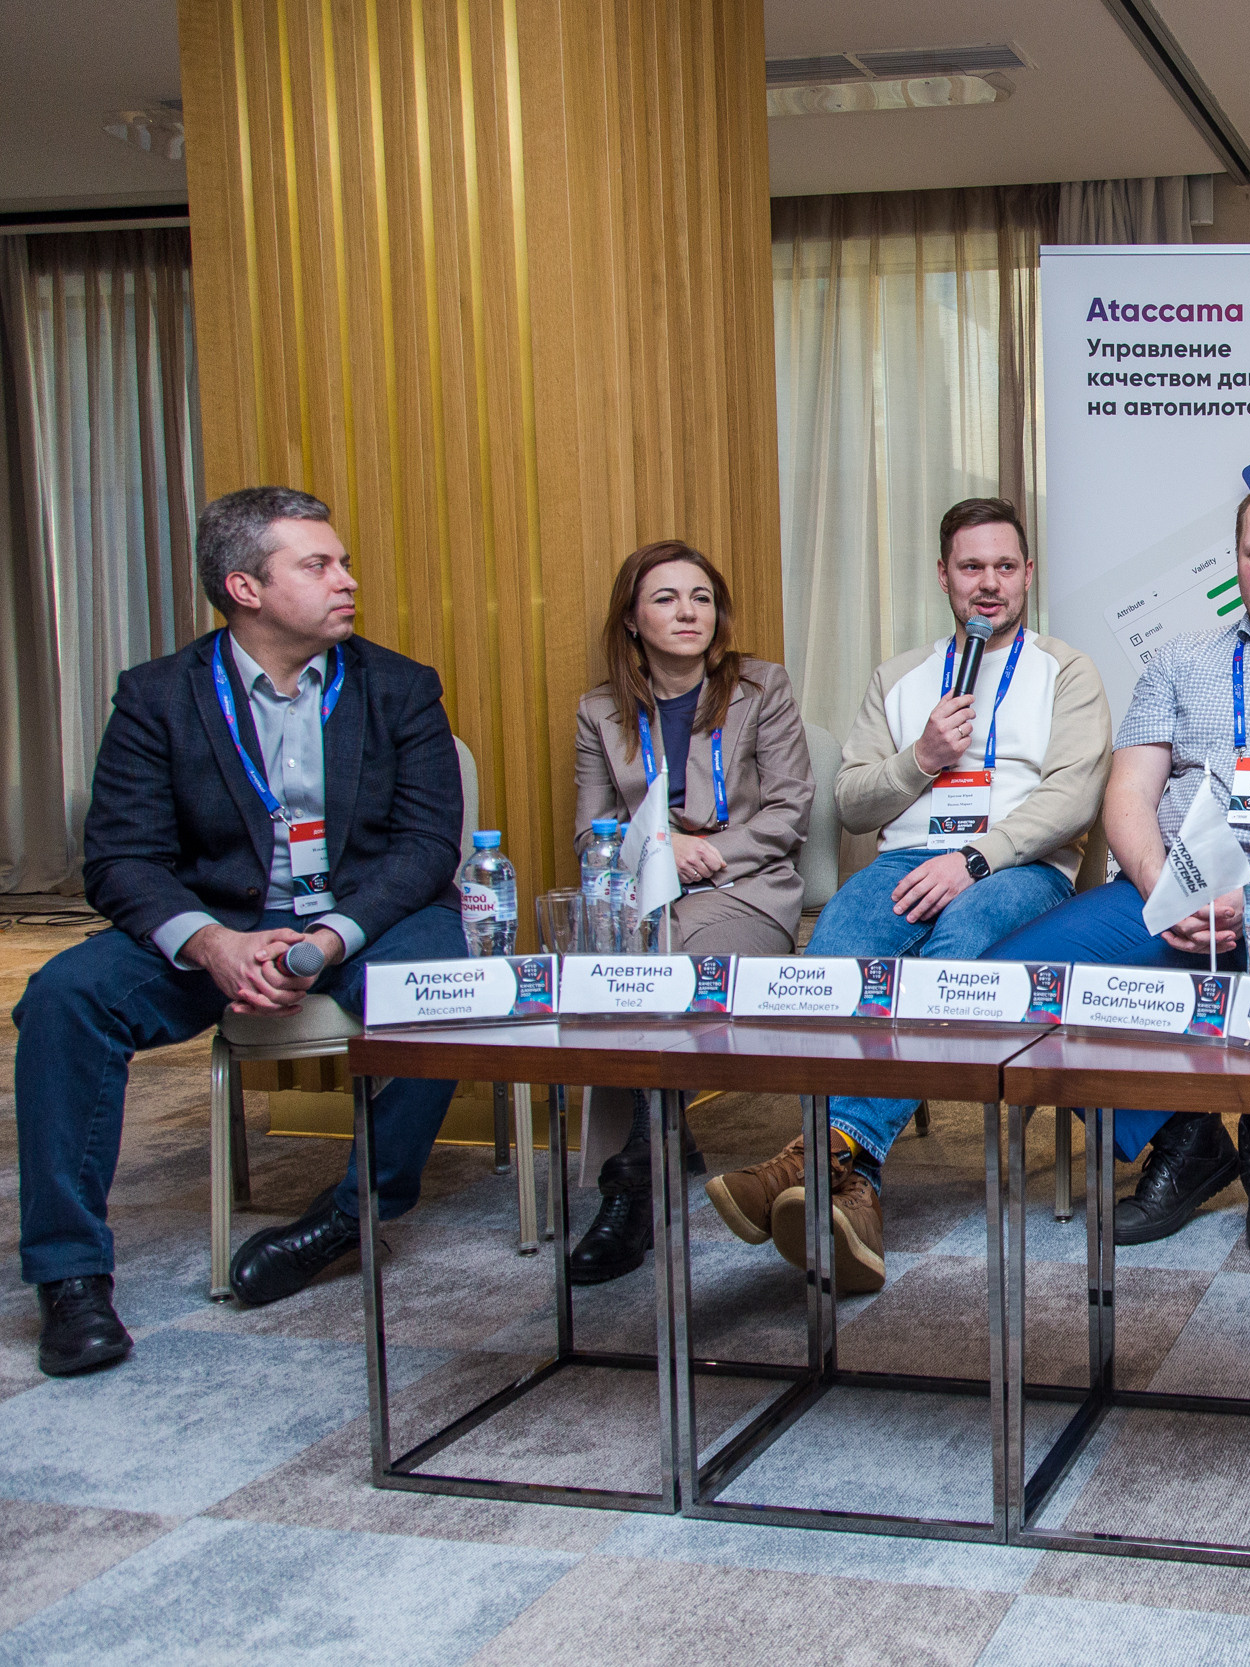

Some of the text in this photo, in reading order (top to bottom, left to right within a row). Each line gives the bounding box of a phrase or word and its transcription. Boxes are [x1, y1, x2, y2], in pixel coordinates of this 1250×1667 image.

[1086, 297, 1243, 322] Ataccama
[1086, 337, 1231, 362] Управление
[1087, 371, 1212, 388] качеством
[1087, 400, 1117, 416] на
[1191, 557, 1217, 574] Validity
[1116, 599, 1145, 619] Attribute
[1144, 622, 1164, 638] email
[404, 969, 485, 986] Алексей
[590, 963, 672, 978] Алевтина
[779, 966, 825, 981] Юрий
[936, 969, 1001, 987] Андрей
[606, 979, 655, 993] Тинас
[767, 981, 833, 997] Кротков
[938, 985, 997, 1002] Трянин
[1106, 976, 1165, 995] Сергей
[415, 986, 475, 1002] Ильин
[417, 1004, 472, 1016] Ataccama
[615, 997, 643, 1008] Tele2
[757, 1001, 840, 1012] «Яндекс.Маркет»
[1082, 991, 1185, 1014] Васильчиков
[926, 1005, 1003, 1018] X5 Retail Group
[1089, 1014, 1172, 1028] «Яндекс.Маркет»
